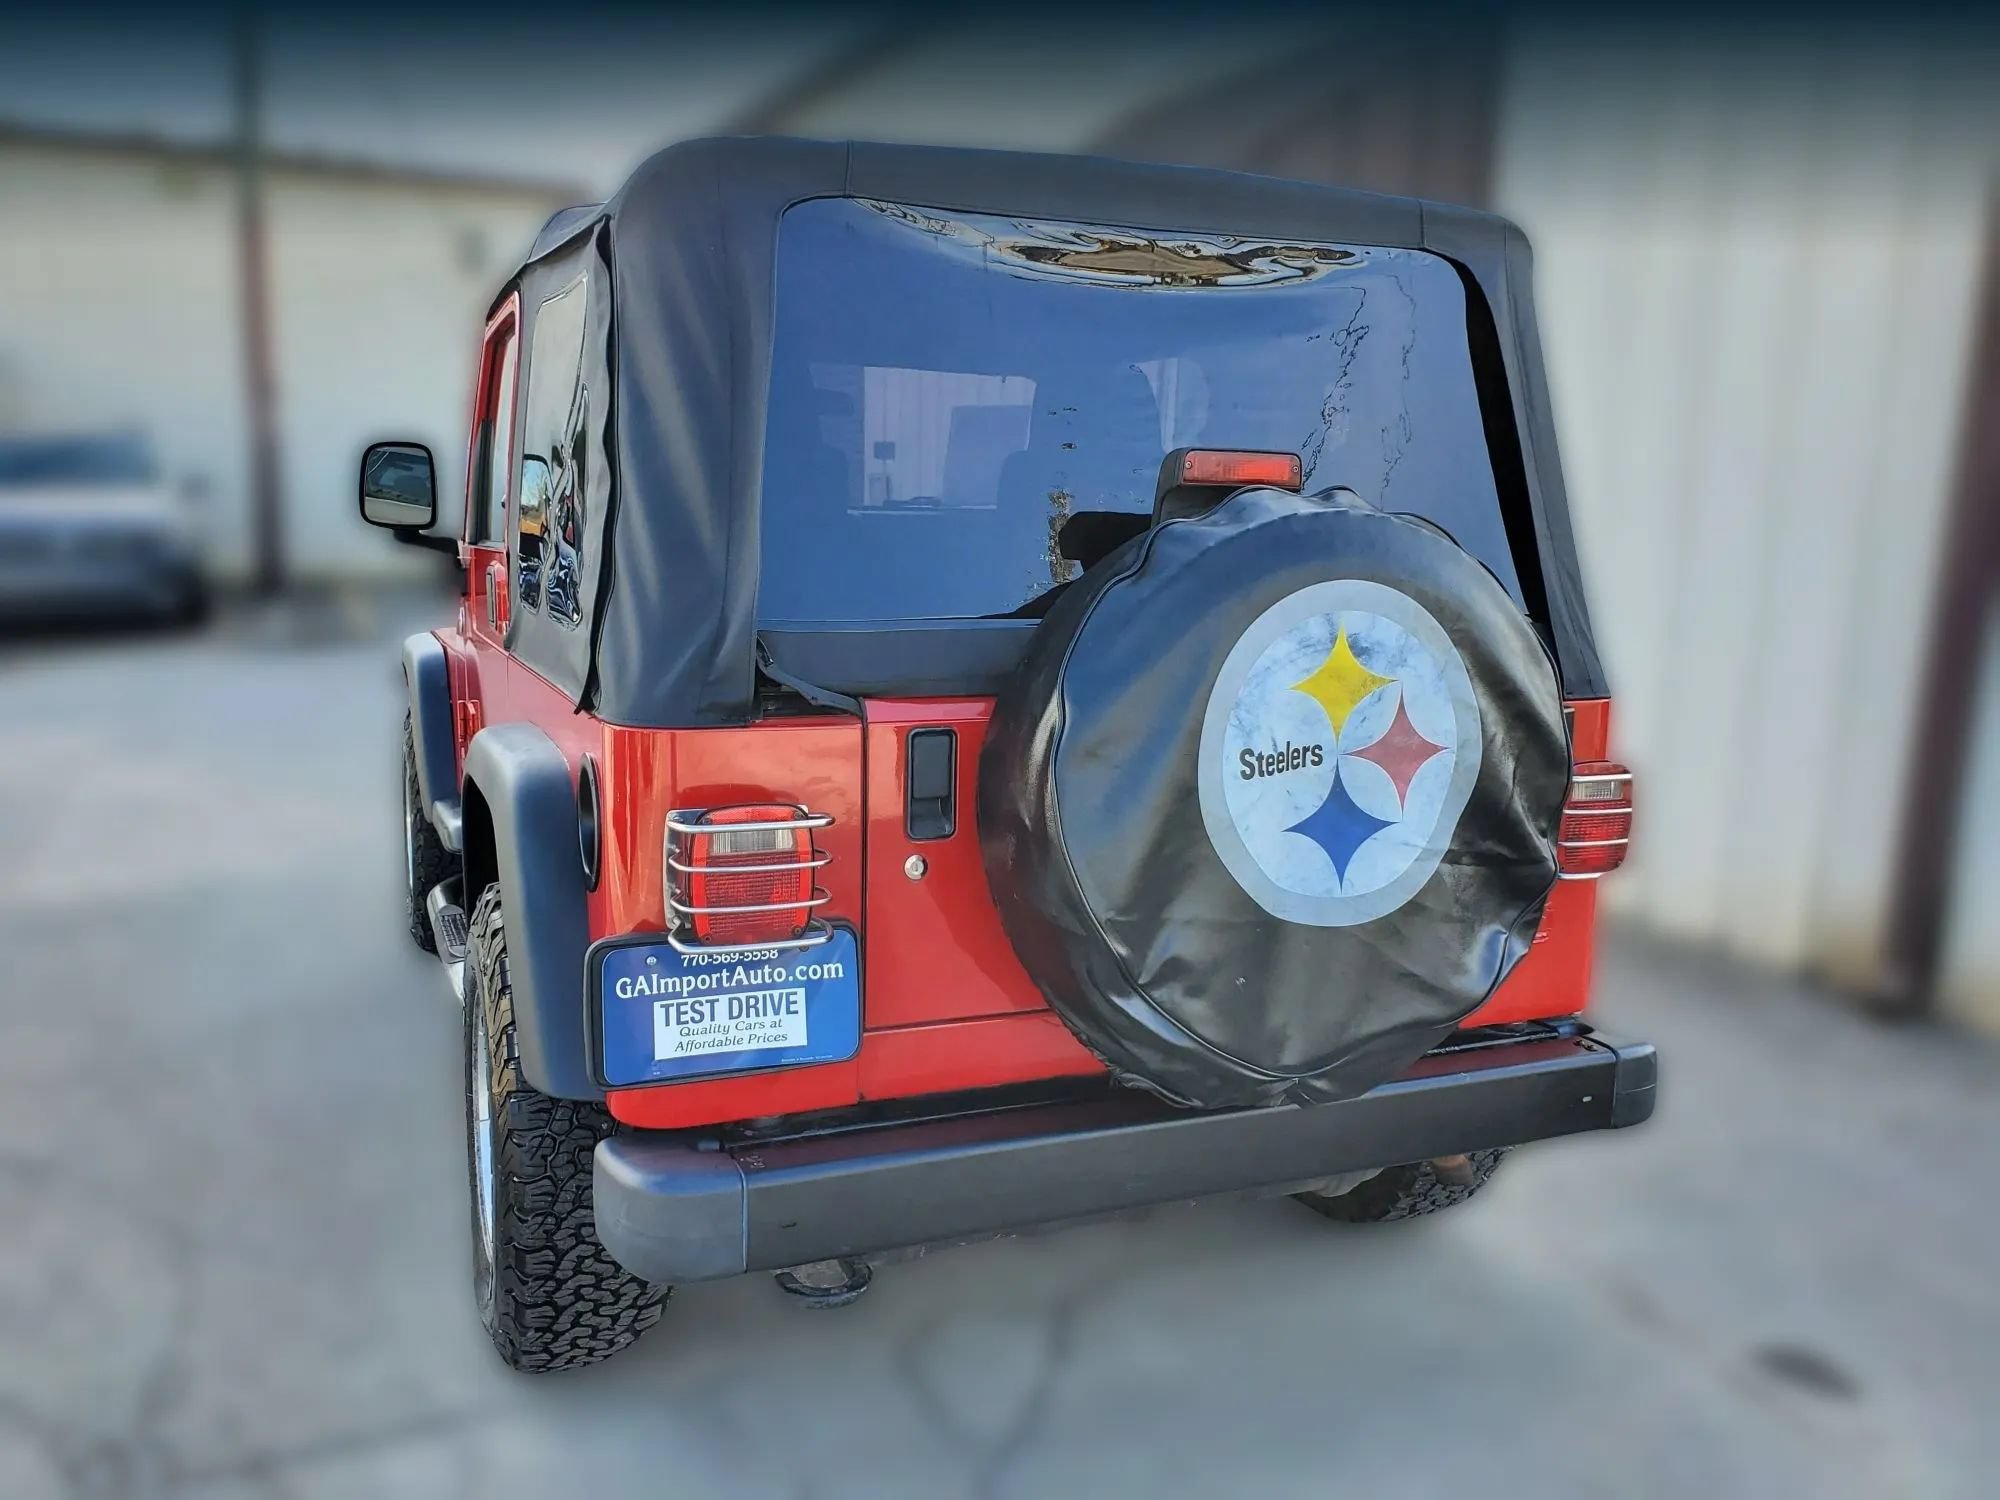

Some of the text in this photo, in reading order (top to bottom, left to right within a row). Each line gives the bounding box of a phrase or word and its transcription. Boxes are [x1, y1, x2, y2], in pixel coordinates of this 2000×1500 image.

[1239, 740, 1324, 781] Steelers
[615, 962, 844, 998] GAImportAuto.com
[660, 991, 799, 1027] TEST DRIVE
[674, 1033, 788, 1052] Affordable Prices
[679, 1018, 783, 1037] Quality Cars at
